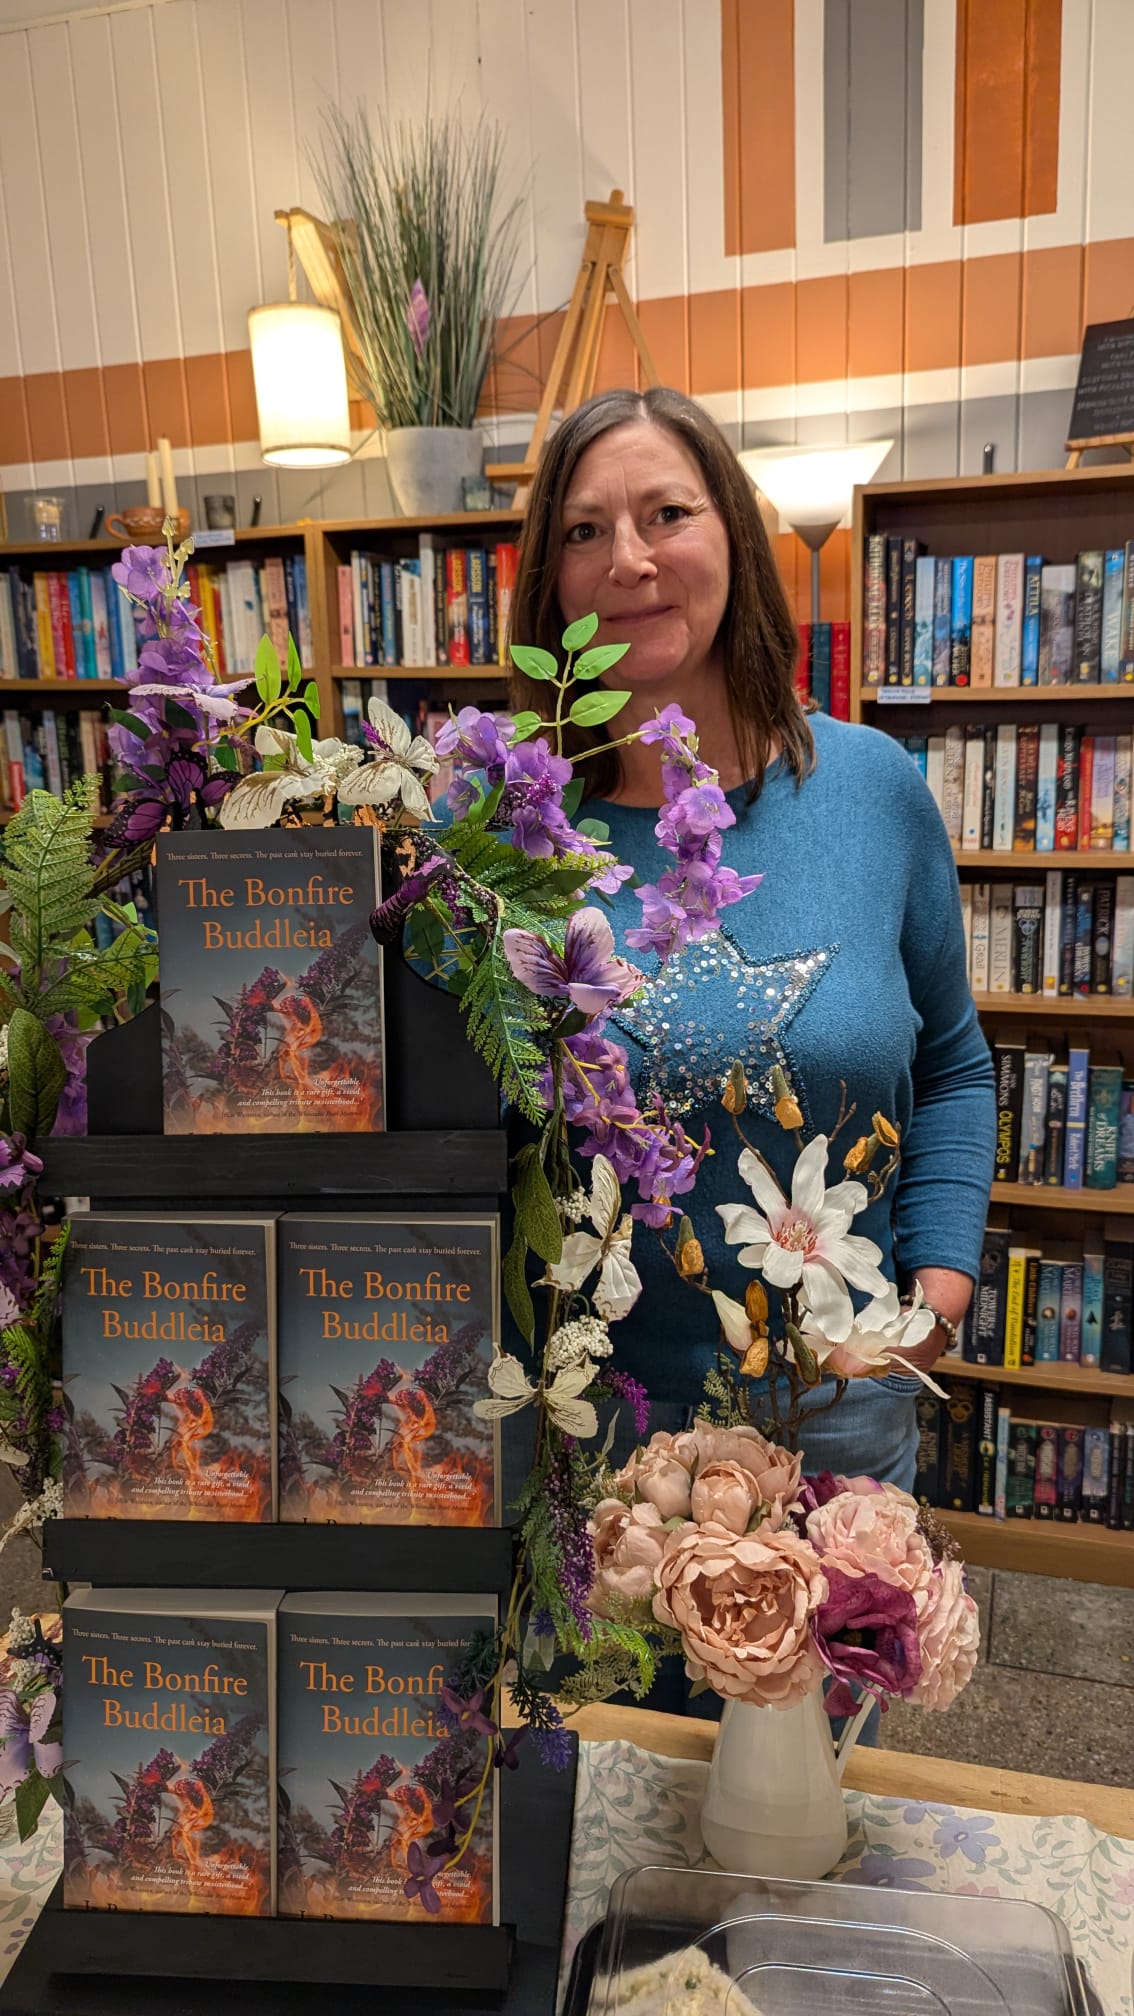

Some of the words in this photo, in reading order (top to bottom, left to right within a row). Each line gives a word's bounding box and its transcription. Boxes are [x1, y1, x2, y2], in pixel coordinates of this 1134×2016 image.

[1029, 574, 1039, 616] ATTILA
[167, 852, 186, 861] Three
[187, 852, 208, 860] sisters.
[300, 851, 313, 860] stay
[178, 877, 235, 908] The
[244, 875, 354, 906] Bonfire
[202, 918, 334, 949] Buddleia
[994, 926, 1008, 982] MERLIN
[999, 1055, 1011, 1106] SIMMONS
[996, 1110, 1013, 1164] OLYMPOS
[1093, 1121, 1105, 1171] DREAMS
[1107, 1126, 1117, 1161] KNIFE
[71, 1240, 87, 1249] Three
[89, 1242, 108, 1250] sisters.
[110, 1242, 128, 1251] Three
[152, 1244, 164, 1252] The
[166, 1246, 179, 1254] past
[196, 1247, 208, 1256] stay
[210, 1247, 231, 1255] buried
[232, 1247, 256, 1256] forever.
[289, 1241, 306, 1249] Three
[308, 1242, 328, 1250] sisters.
[331, 1243, 348, 1251] Three
[350, 1244, 371, 1252] secrets.
[375, 1245, 387, 1253] The
[388, 1247, 401, 1255] past
[419, 1247, 432, 1256] stay
[434, 1247, 455, 1255] buried
[457, 1248, 481, 1256] forever.
[80, 1267, 133, 1297] The
[142, 1271, 247, 1302] Bonfire
[299, 1267, 353, 1298] The
[364, 1271, 471, 1302] Bonfire
[102, 1310, 226, 1343] Buddleia
[321, 1311, 450, 1343] Buddleia
[978, 1285, 989, 1337] MIDNIGHT
[72, 1628, 89, 1637] Three
[91, 1631, 110, 1639] sisters.
[112, 1632, 129, 1641] Three
[130, 1635, 152, 1643] secrets.
[154, 1635, 166, 1644] The
[168, 1638, 180, 1646] past
[198, 1640, 210, 1649] stay
[212, 1640, 232, 1648] buried
[234, 1641, 258, 1650] forever.
[290, 1633, 307, 1642] Three
[309, 1635, 330, 1644] sisters.
[332, 1637, 350, 1646] Three
[352, 1638, 374, 1646] secrets.
[376, 1638, 389, 1647] The
[390, 1640, 403, 1648] past
[422, 1640, 436, 1649] stay
[437, 1639, 457, 1647] buried
[82, 1655, 134, 1687] The
[144, 1661, 248, 1696] Bonfire
[299, 1661, 355, 1692] The
[365, 1664, 444, 1695] Bonfi
[102, 1699, 227, 1735] Buddleia
